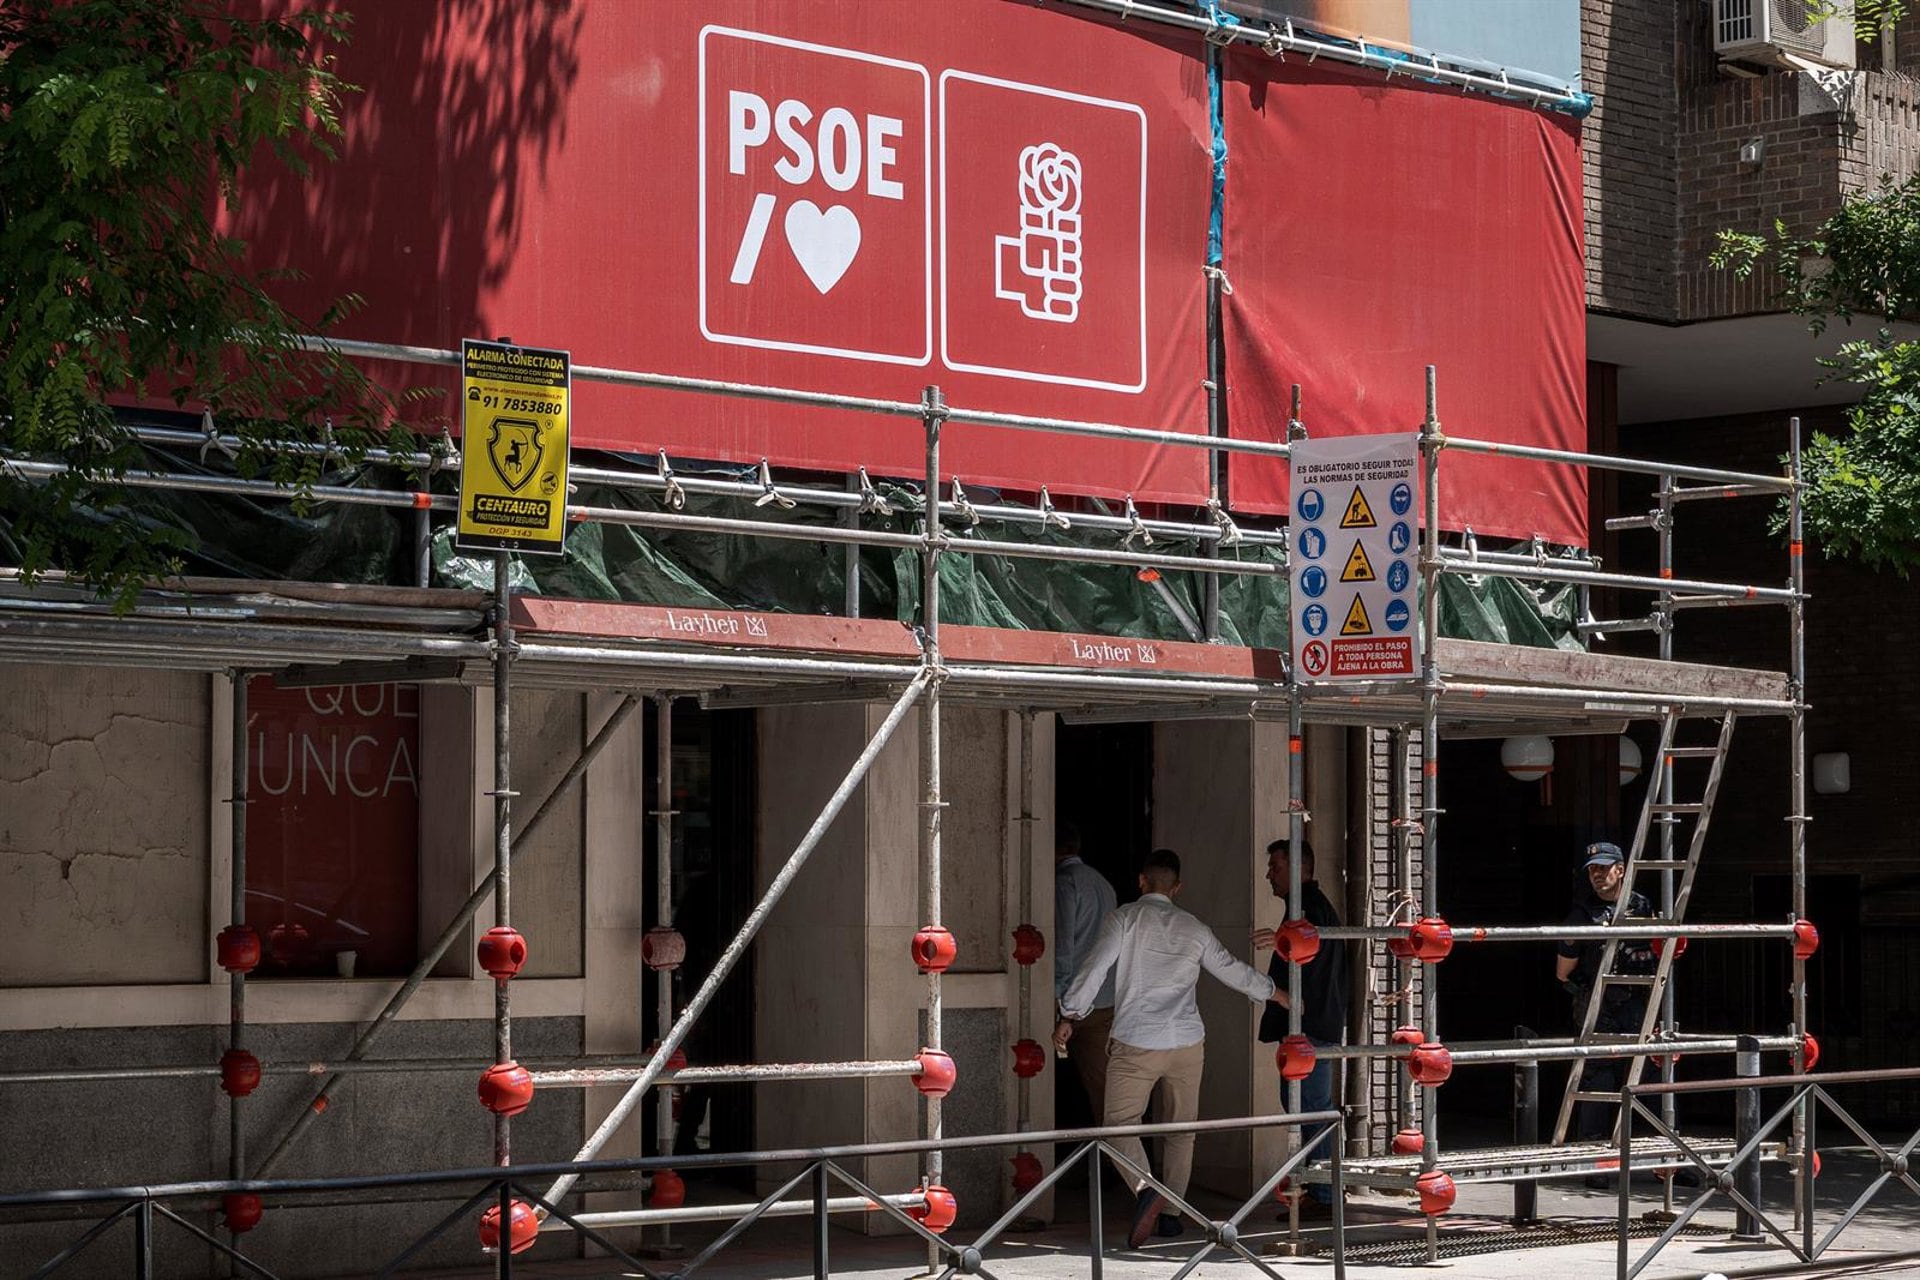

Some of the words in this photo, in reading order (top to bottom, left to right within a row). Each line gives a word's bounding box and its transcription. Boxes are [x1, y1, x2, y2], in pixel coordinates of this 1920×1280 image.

[729, 89, 904, 200] PSOE
[467, 348, 506, 364] ALARMA
[507, 352, 564, 370] CONECTADA
[529, 368, 542, 377] CON
[483, 396, 499, 408] 91
[503, 398, 562, 415] 7853880
[1297, 466, 1307, 474] ES
[1308, 462, 1360, 474] OBLIGATORIO
[1361, 460, 1391, 470] SEGUIR
[1392, 459, 1414, 468] TODAS
[1304, 475, 1318, 484] LAS
[1320, 473, 1353, 483] NORMAS
[1355, 473, 1366, 481] DE
[1367, 470, 1409, 481] SEGURIDAD
[477, 497, 548, 516] CENTAURO
[489, 527, 509, 535] DGP
[666, 610, 739, 636] Layher
[1070, 638, 1132, 664] Layher
[1334, 643, 1374, 652] PROHIBIDO
[1386, 642, 1408, 650] PASO
[1338, 653, 1344, 661] A
[1345, 652, 1365, 661] TODA
[1366, 651, 1402, 660] PERSONA
[1337, 662, 1361, 671] AJENA
[1362, 662, 1368, 670] A
[1369, 661, 1380, 670] LA
[1380, 661, 1404, 669] OBRA
[245, 730, 418, 797] UNCA
